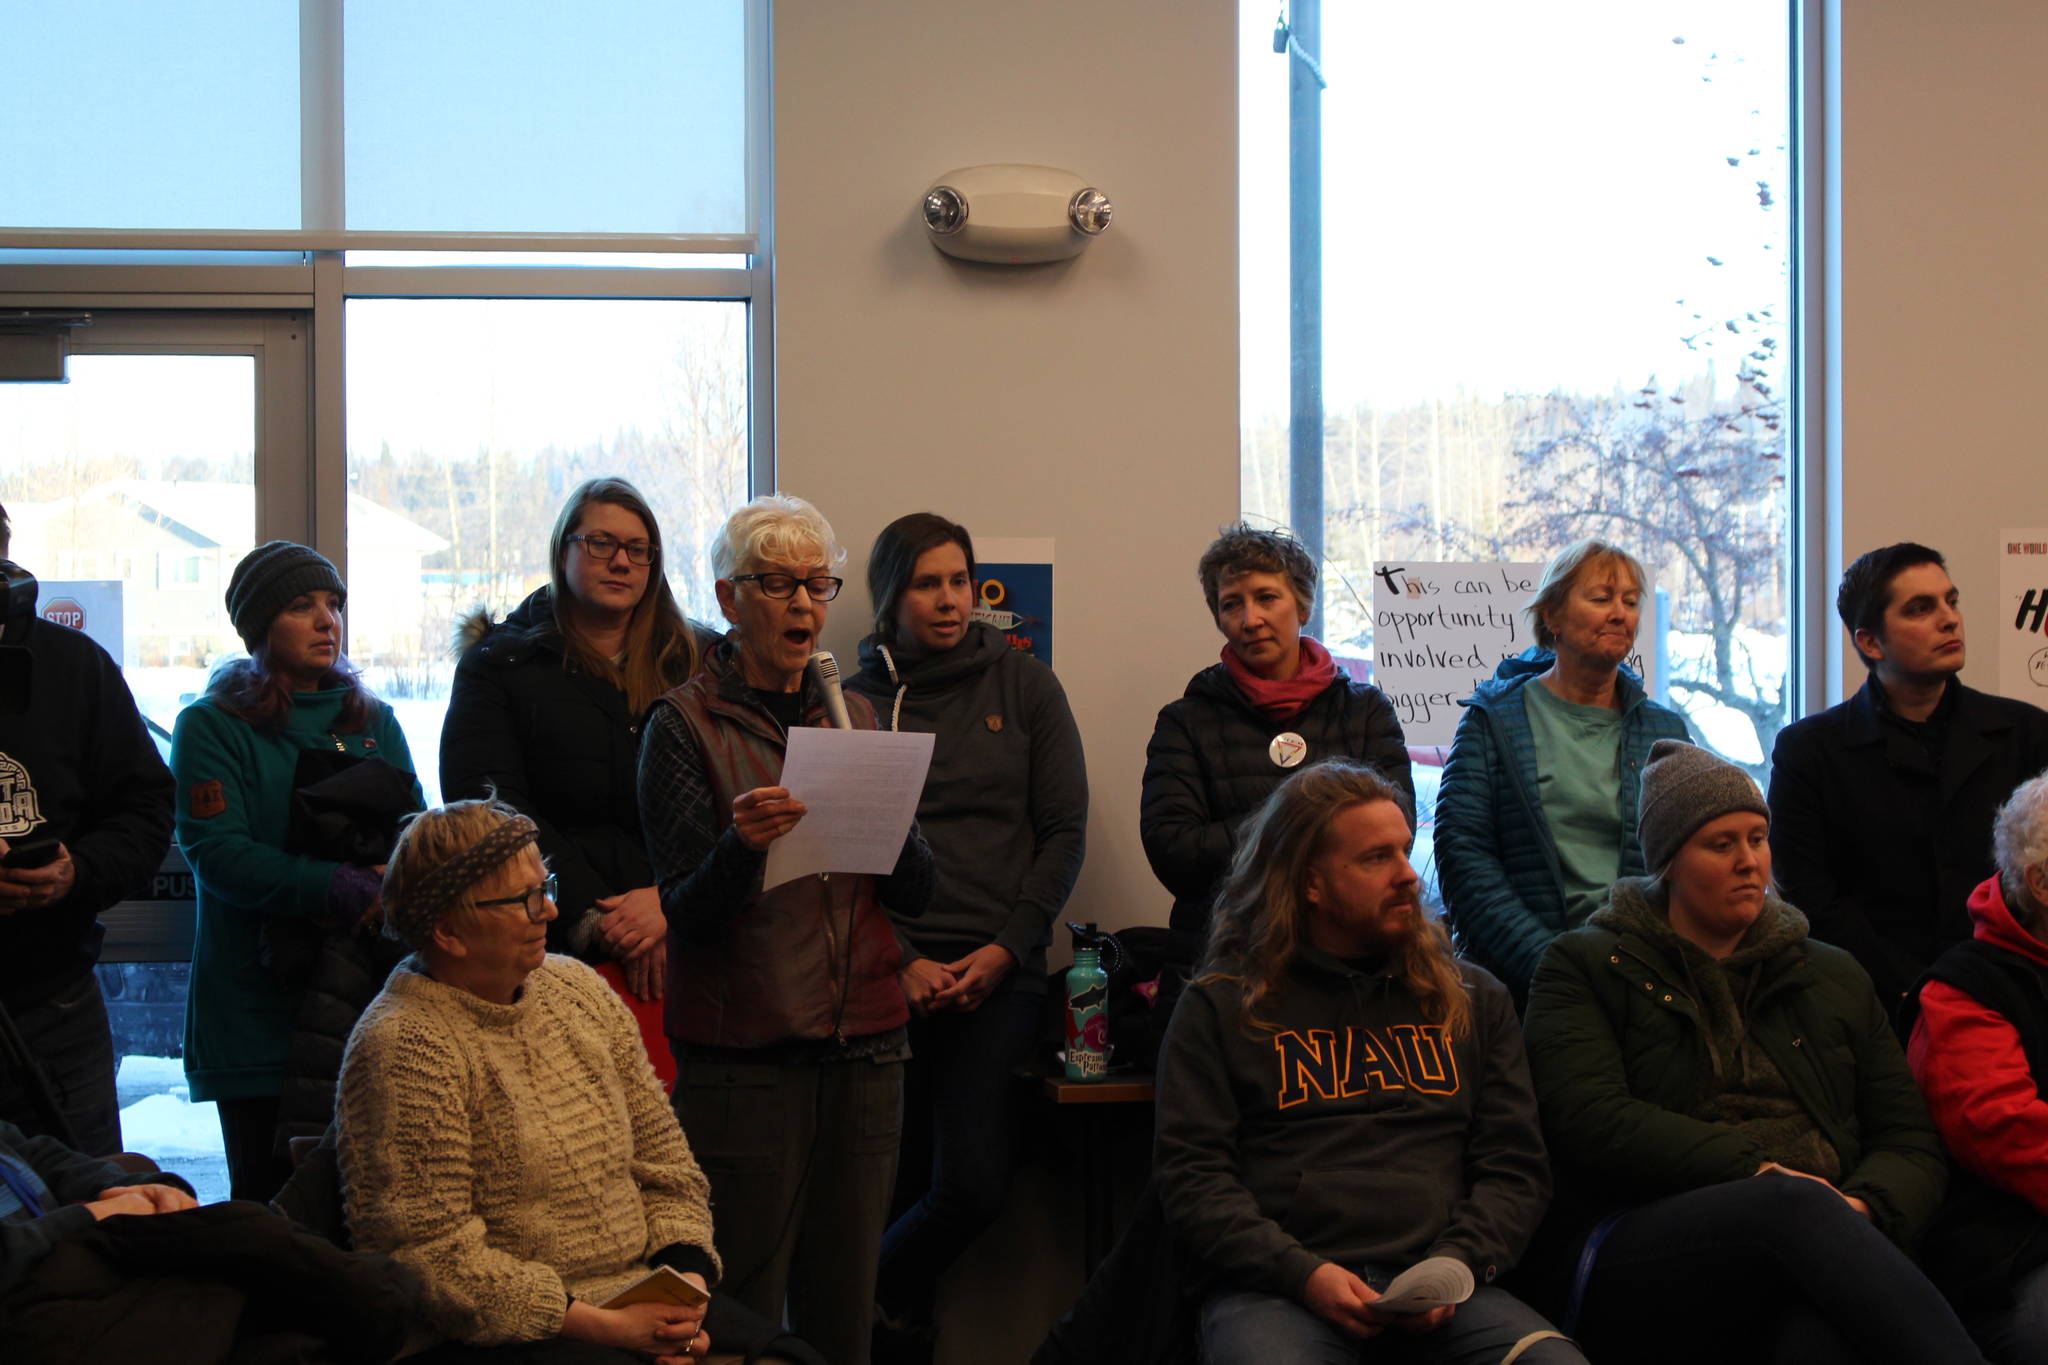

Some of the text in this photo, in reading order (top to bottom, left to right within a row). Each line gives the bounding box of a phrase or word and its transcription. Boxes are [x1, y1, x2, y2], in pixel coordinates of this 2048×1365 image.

[2008, 543, 2048, 554] ONE WORLD
[1375, 566, 1538, 595] This can be
[47, 611, 81, 627] STOP
[1378, 604, 1515, 643] opportunity
[1380, 644, 1488, 669] involved
[1274, 1024, 1460, 1110] NAU
